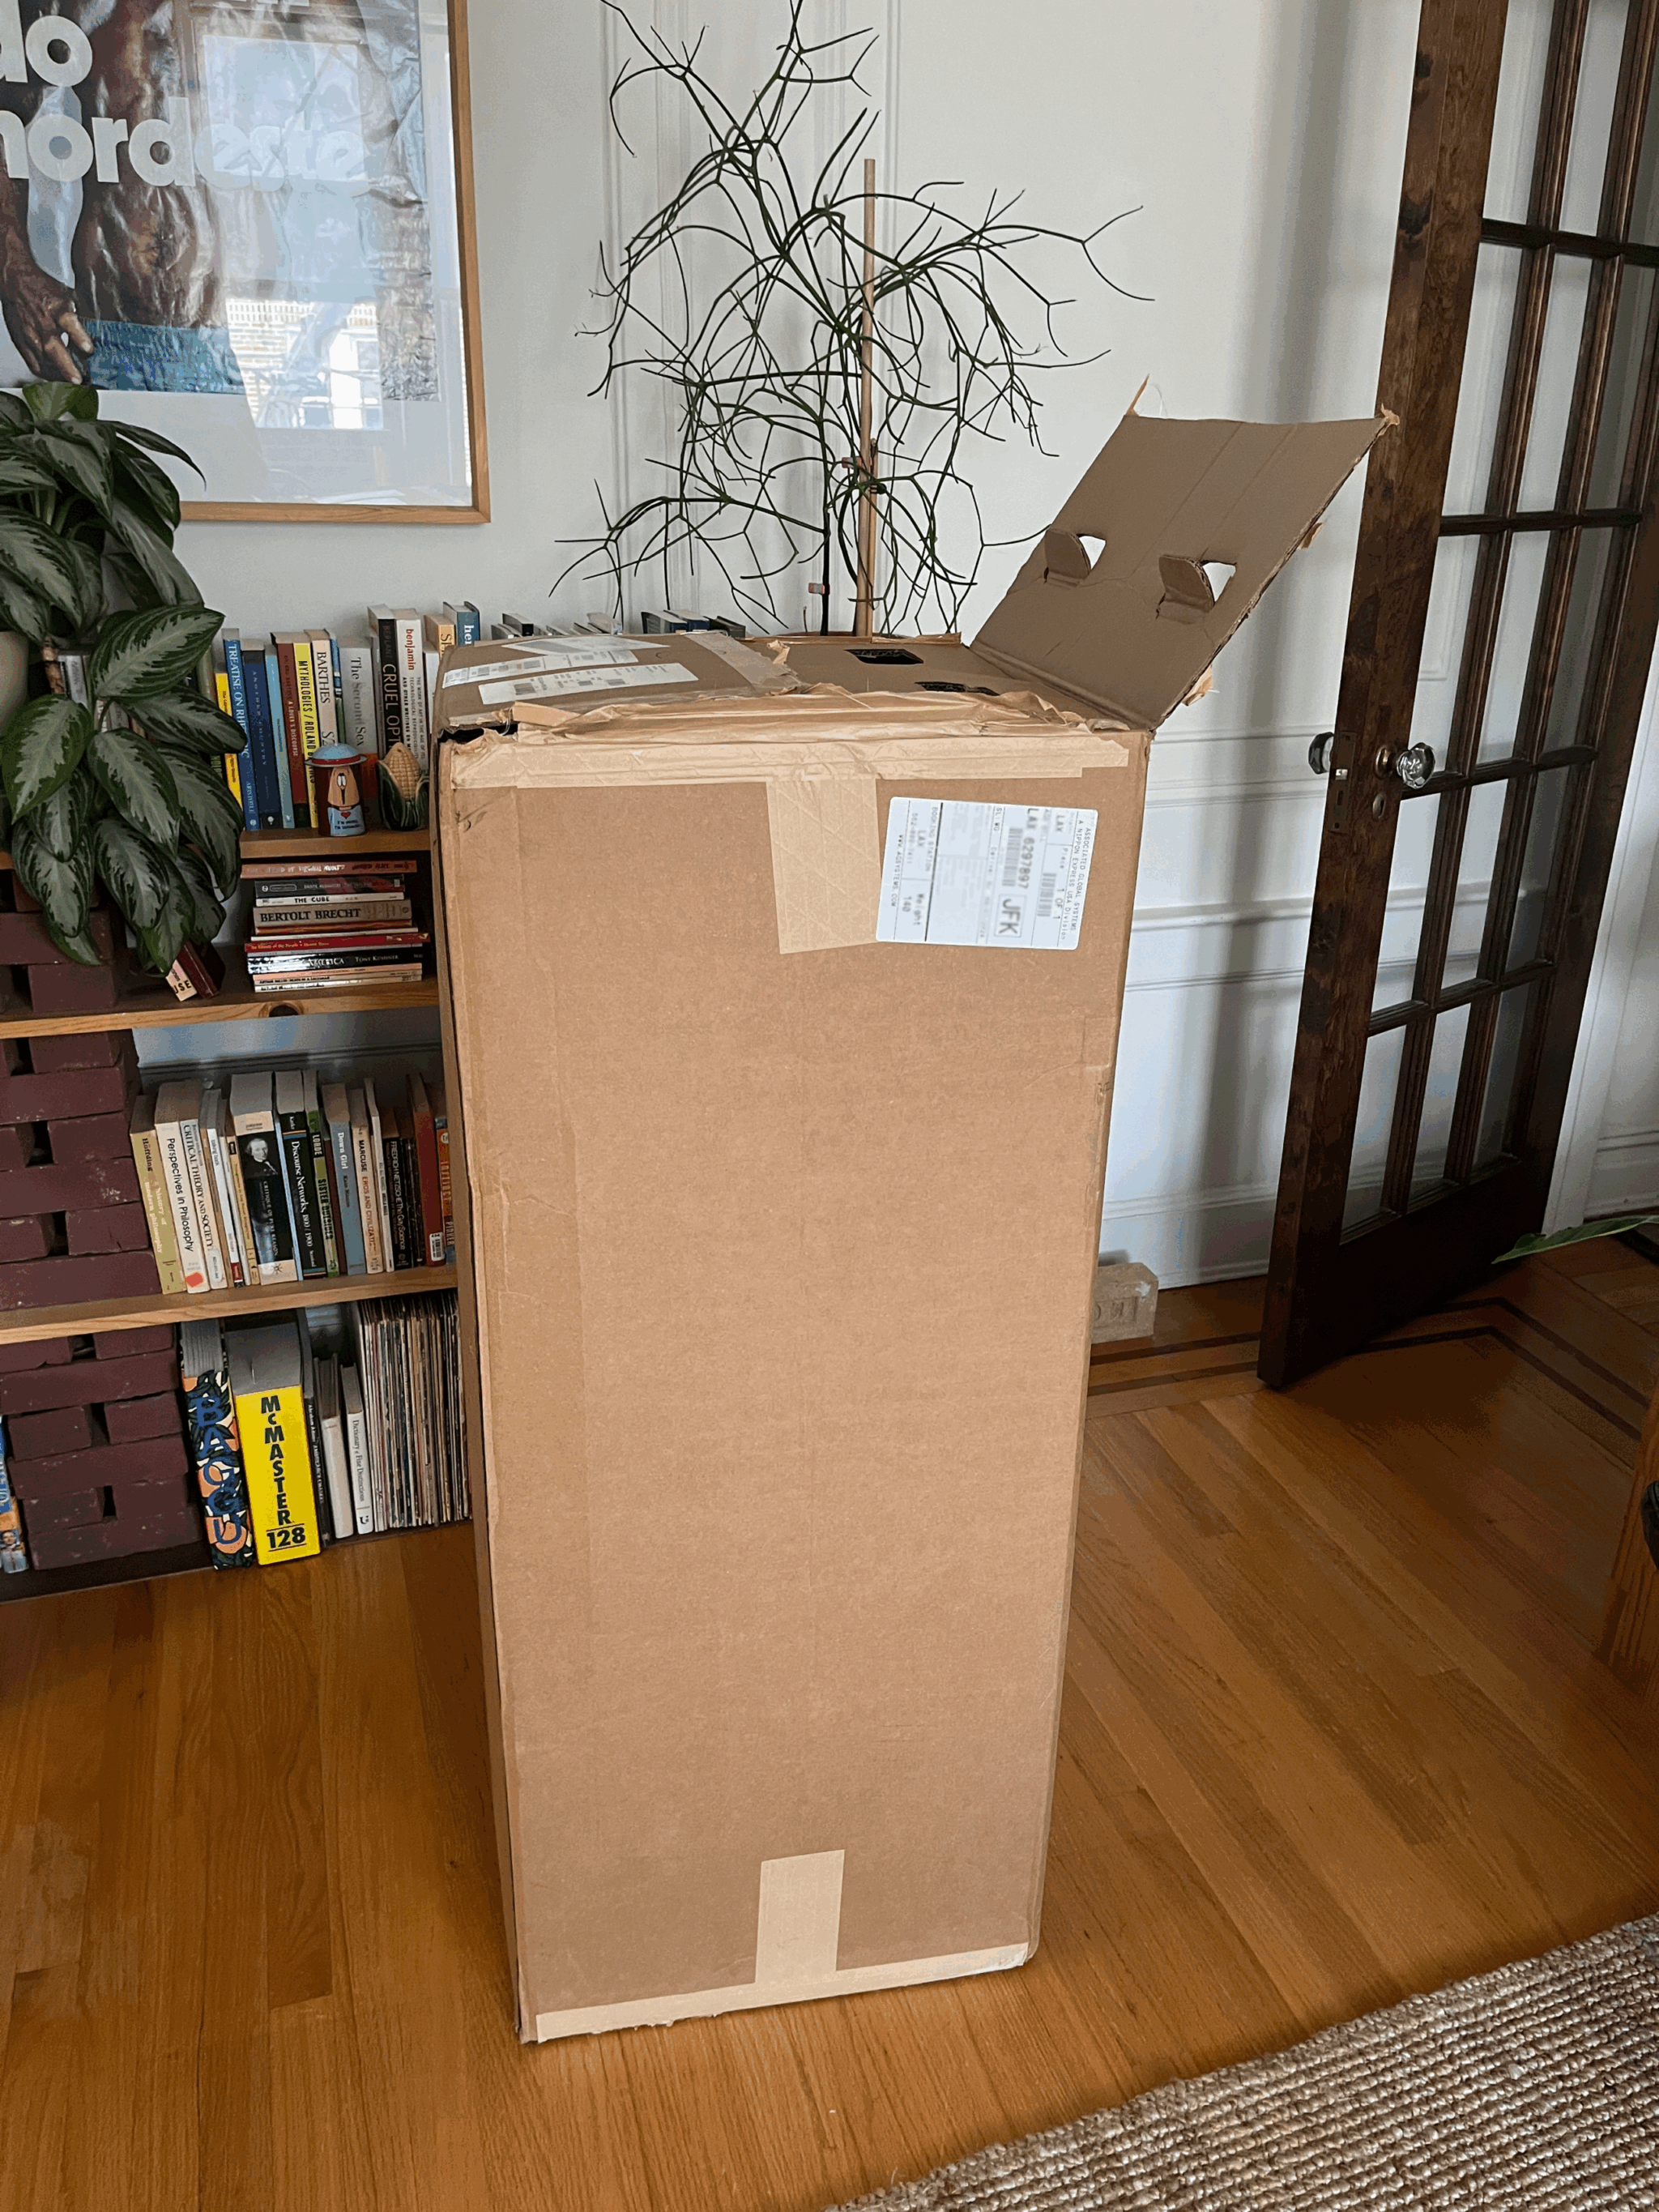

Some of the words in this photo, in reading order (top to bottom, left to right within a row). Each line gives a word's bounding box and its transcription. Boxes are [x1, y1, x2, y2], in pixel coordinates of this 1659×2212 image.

[405, 629, 416, 671] benjamin
[228, 644, 242, 690] TREATISE
[317, 651, 330, 703] BARTHES
[351, 657, 363, 679] The
[233, 692, 244, 707] ON
[298, 660, 313, 712] MYTHOLOGIES
[382, 664, 398, 710] CRUEL
[352, 682, 366, 725] Second
[290, 728, 298, 757] DISCOURSE
[305, 721, 316, 749] ROLAND
[355, 727, 367, 746] Sex
[928, 807, 938, 838] BOOKING
[1026, 808, 1039, 829] LAX
[1056, 815, 1065, 832] LAX
[918, 830, 927, 848] LAX
[1074, 828, 1082, 854] NIPPON
[1080, 828, 1091, 869] ASSOCIATED
[925, 842, 934, 872] STATION
[1018, 837, 1036, 890] 6297897
[1060, 848, 1068, 869] Piece
[1069, 858, 1078, 887] EXPRESS
[1075, 873, 1085, 898] GLOBAL
[913, 893, 925, 925] Weight
[1055, 898, 1063, 908] OF
[1066, 890, 1074, 903] USA
[260, 911, 311, 923] BERTOLT
[314, 907, 361, 920] BRECHT
[999, 899, 1021, 934] JFK
[1061, 907, 1071, 940] Division
[1070, 903, 1080, 931] SYSTEMS
[312, 1134, 322, 1155] LORDE
[337, 1133, 346, 1153] Down
[359, 1139, 368, 1172] MARCUSE
[390, 1141, 399, 1170] FRIEDRICH
[167, 1138, 184, 1194] Perspectives
[291, 1141, 303, 1176] Discourse
[340, 1155, 349, 1169] Girl
[145, 1181, 155, 1211] modern
[183, 1125, 197, 1164] CRITICAL
[192, 1166, 204, 1198] THEORY
[201, 1214, 213, 1247] SOCIETY
[263, 1181, 271, 1208] CRITIQUE
[296, 1176, 308, 1212] Networks,
[318, 1179, 329, 1204] SISTER
[362, 1176, 370, 1194] EROS
[392, 1170, 402, 1203] NIETZSCHE
[155, 1187, 164, 1214] history
[160, 1217, 168, 1225] of
[177, 1197, 186, 1205] in
[365, 1196, 373, 1209] AND
[395, 1203, 403, 1214] The
[440, 1161, 451, 1202] INSTINCT
[446, 1221, 455, 1245] PINKER
[149, 1212, 164, 1253] philosophy
[179, 1206, 194, 1253] Philosophy
[301, 1214, 310, 1228] 1800
[321, 1206, 333, 1241] OUTSIDER
[394, 1214, 405, 1226] Gay
[305, 1232, 313, 1246] 1900
[398, 1226, 406, 1250] Science
[309, 1249, 317, 1267] Stanford
[352, 1420, 363, 1450] Dictionary
[197, 1396, 242, 1544] BAGGU
[356, 1455, 364, 1467] Fine
[357, 1468, 366, 1501] Distinctions
[267, 1527, 306, 1548] 128
